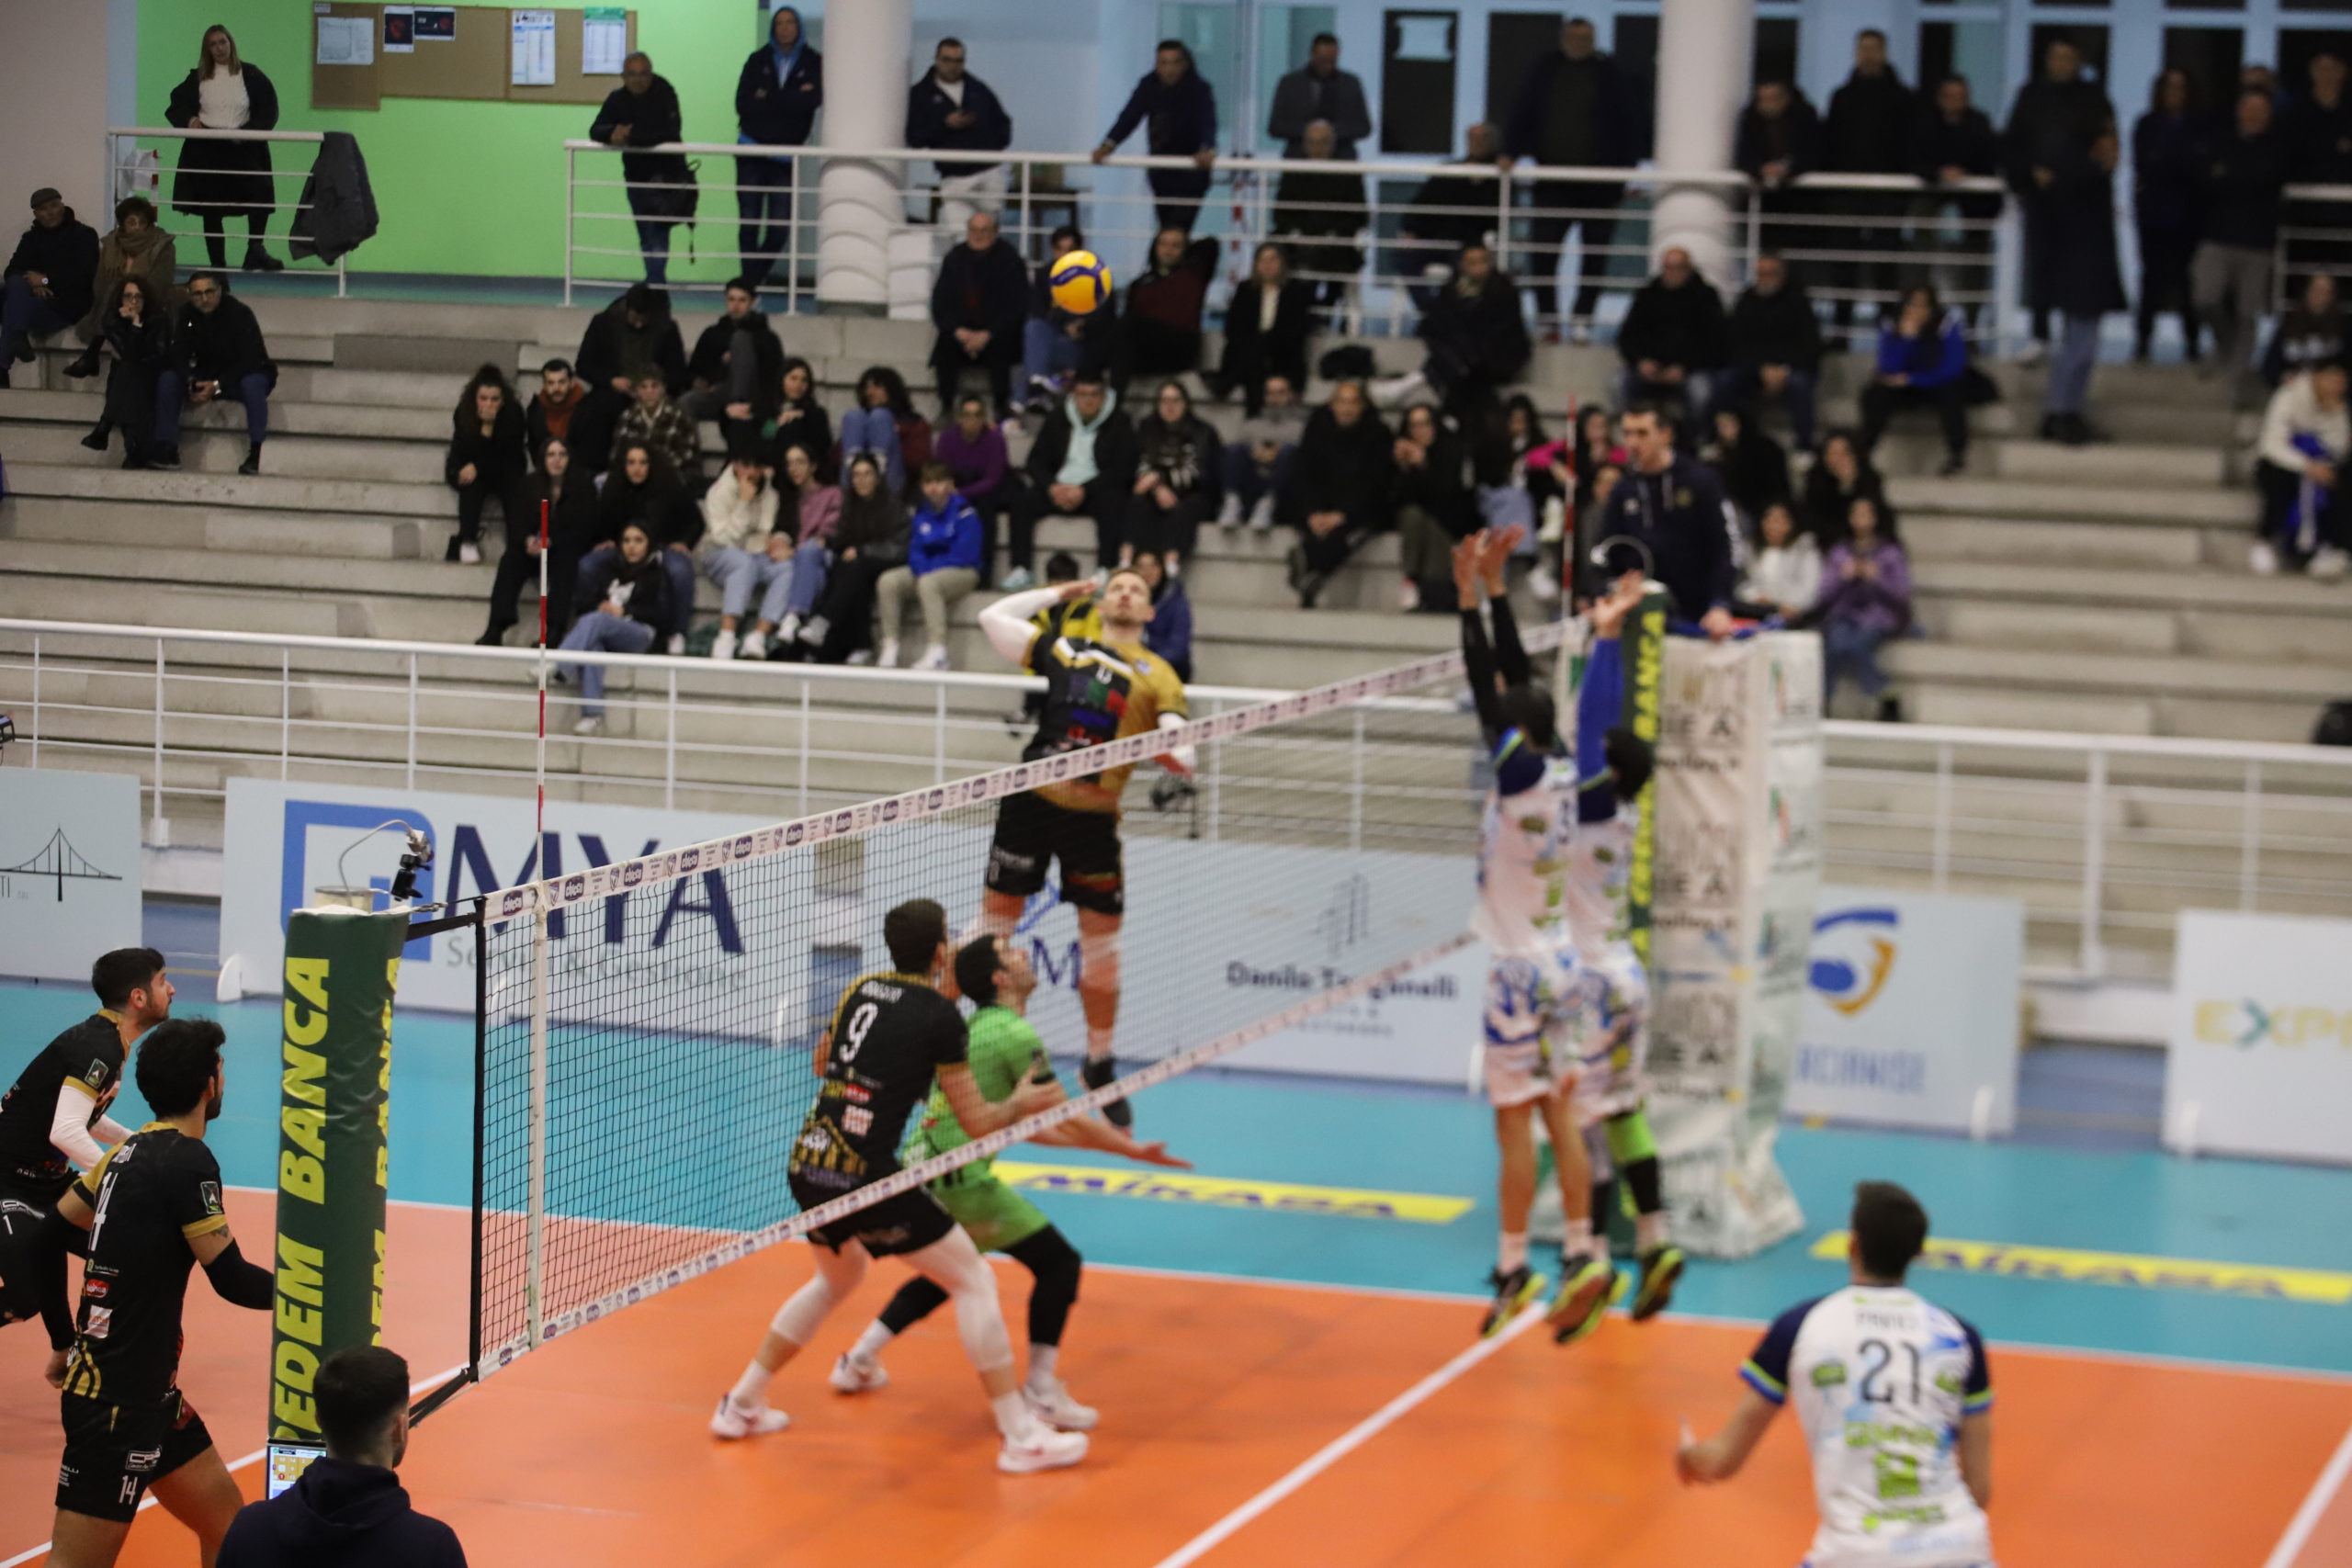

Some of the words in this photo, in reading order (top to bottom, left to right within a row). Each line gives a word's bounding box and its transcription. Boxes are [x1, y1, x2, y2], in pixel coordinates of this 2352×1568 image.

[839, 1002, 878, 1063] 9
[279, 957, 329, 1204] BANCA
[1858, 1338, 1921, 1405] 21
[119, 1475, 139, 1505] 14
